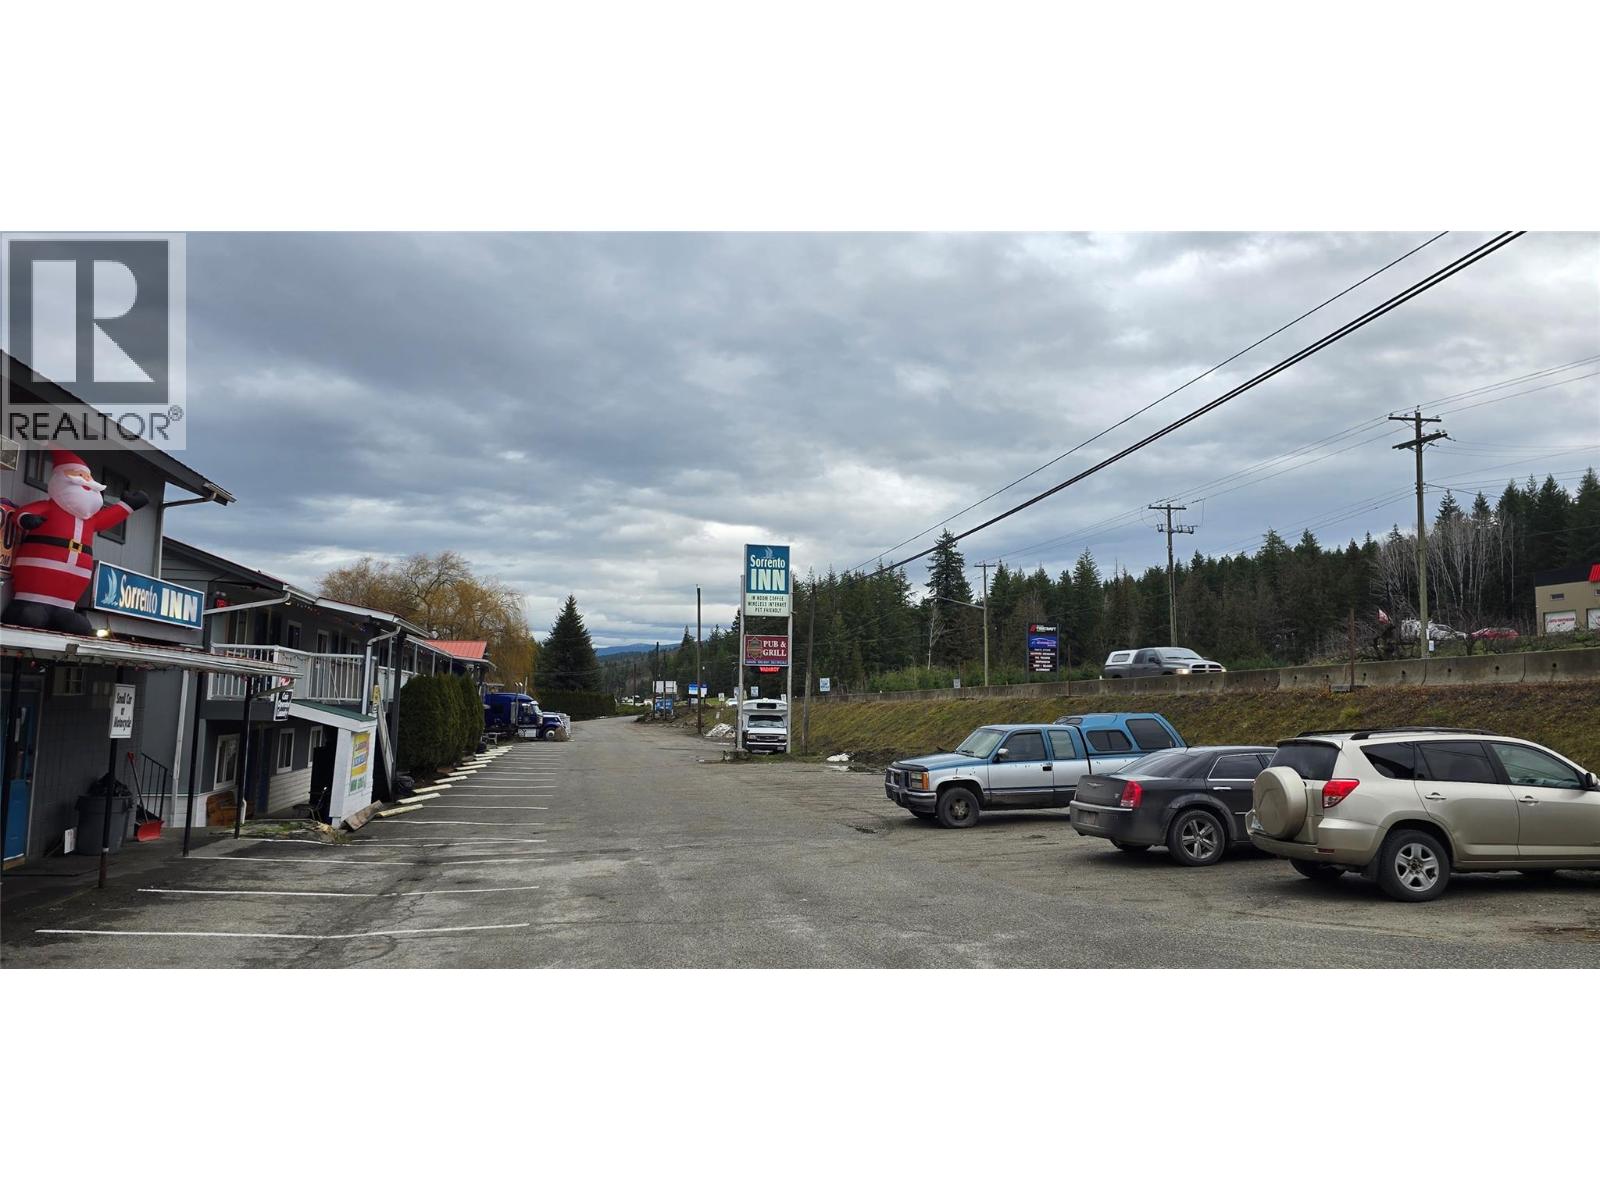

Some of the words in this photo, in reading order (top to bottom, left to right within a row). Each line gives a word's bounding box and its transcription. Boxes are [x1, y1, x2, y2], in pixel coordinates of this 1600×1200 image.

[750, 554, 786, 569] Sorrento
[750, 568, 786, 591] INN
[119, 573, 158, 615] Sorrento
[160, 587, 198, 623] INN
[763, 640, 779, 648] PUB
[780, 640, 787, 649] &
[762, 648, 787, 657] GRILL
